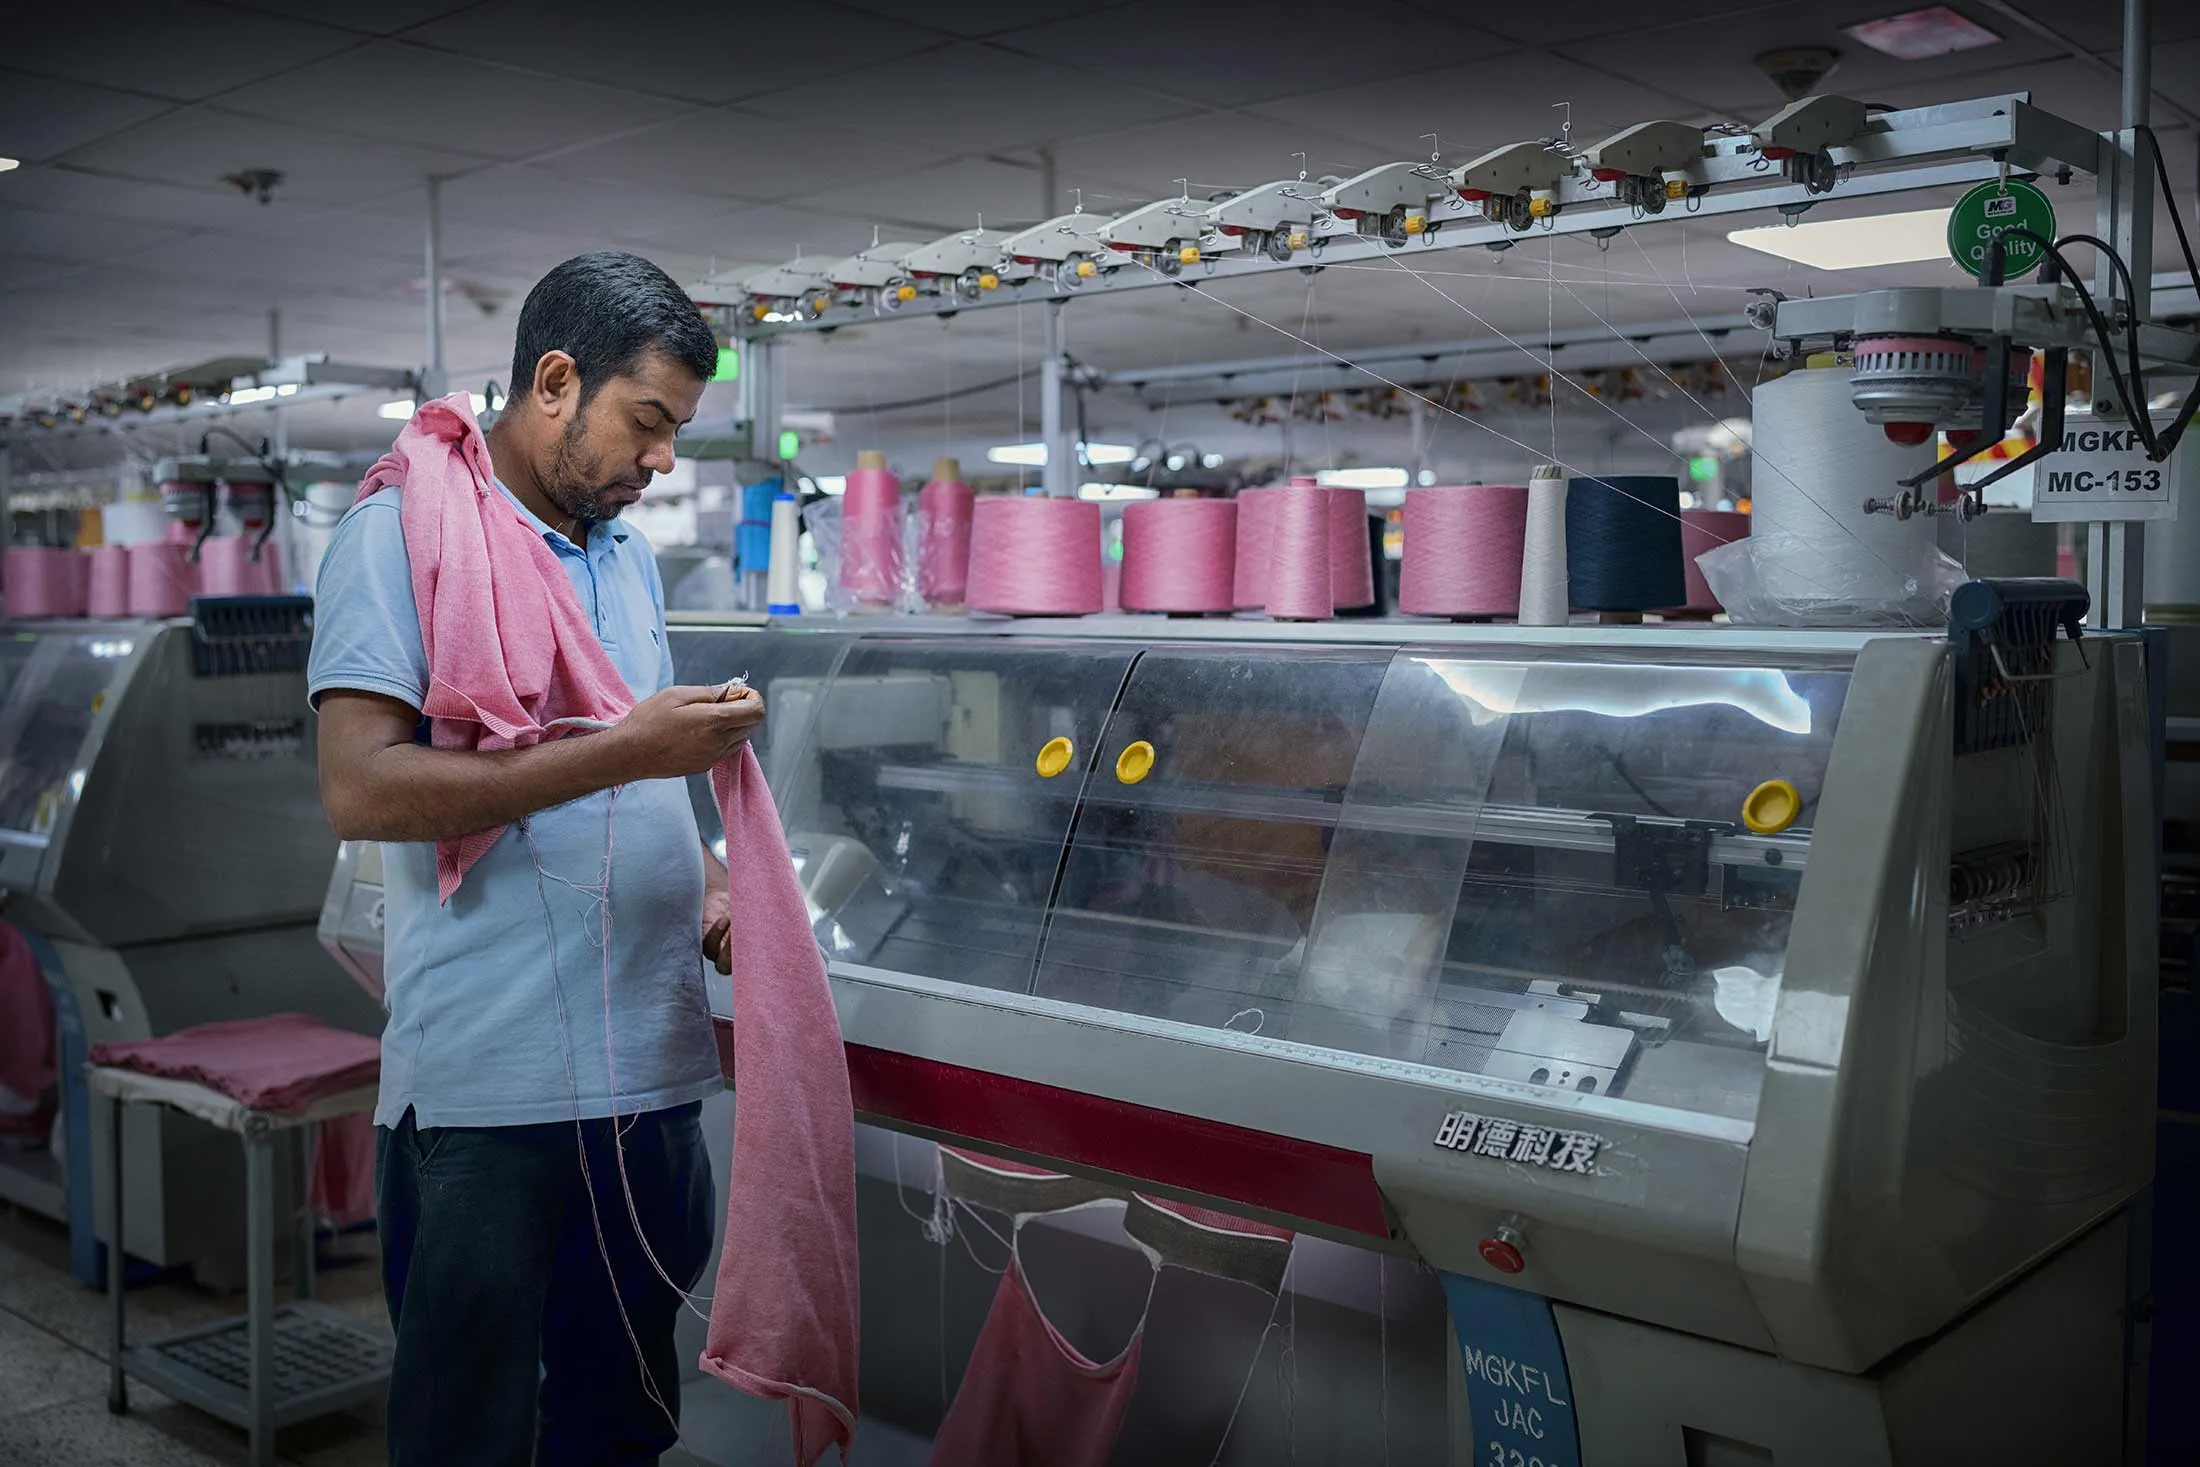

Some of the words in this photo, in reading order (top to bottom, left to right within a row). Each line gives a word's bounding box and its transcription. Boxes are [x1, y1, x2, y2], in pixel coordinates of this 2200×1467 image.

[1988, 199, 2013, 212] MG
[1970, 239, 2037, 260] Qlity
[2053, 430, 2144, 453] MGKF
[2048, 470, 2161, 493] MC-153
[1433, 1111, 1599, 1175] 明德科技
[1464, 1345, 1567, 1406] MGKFL
[1493, 1398, 1544, 1440] JAC
